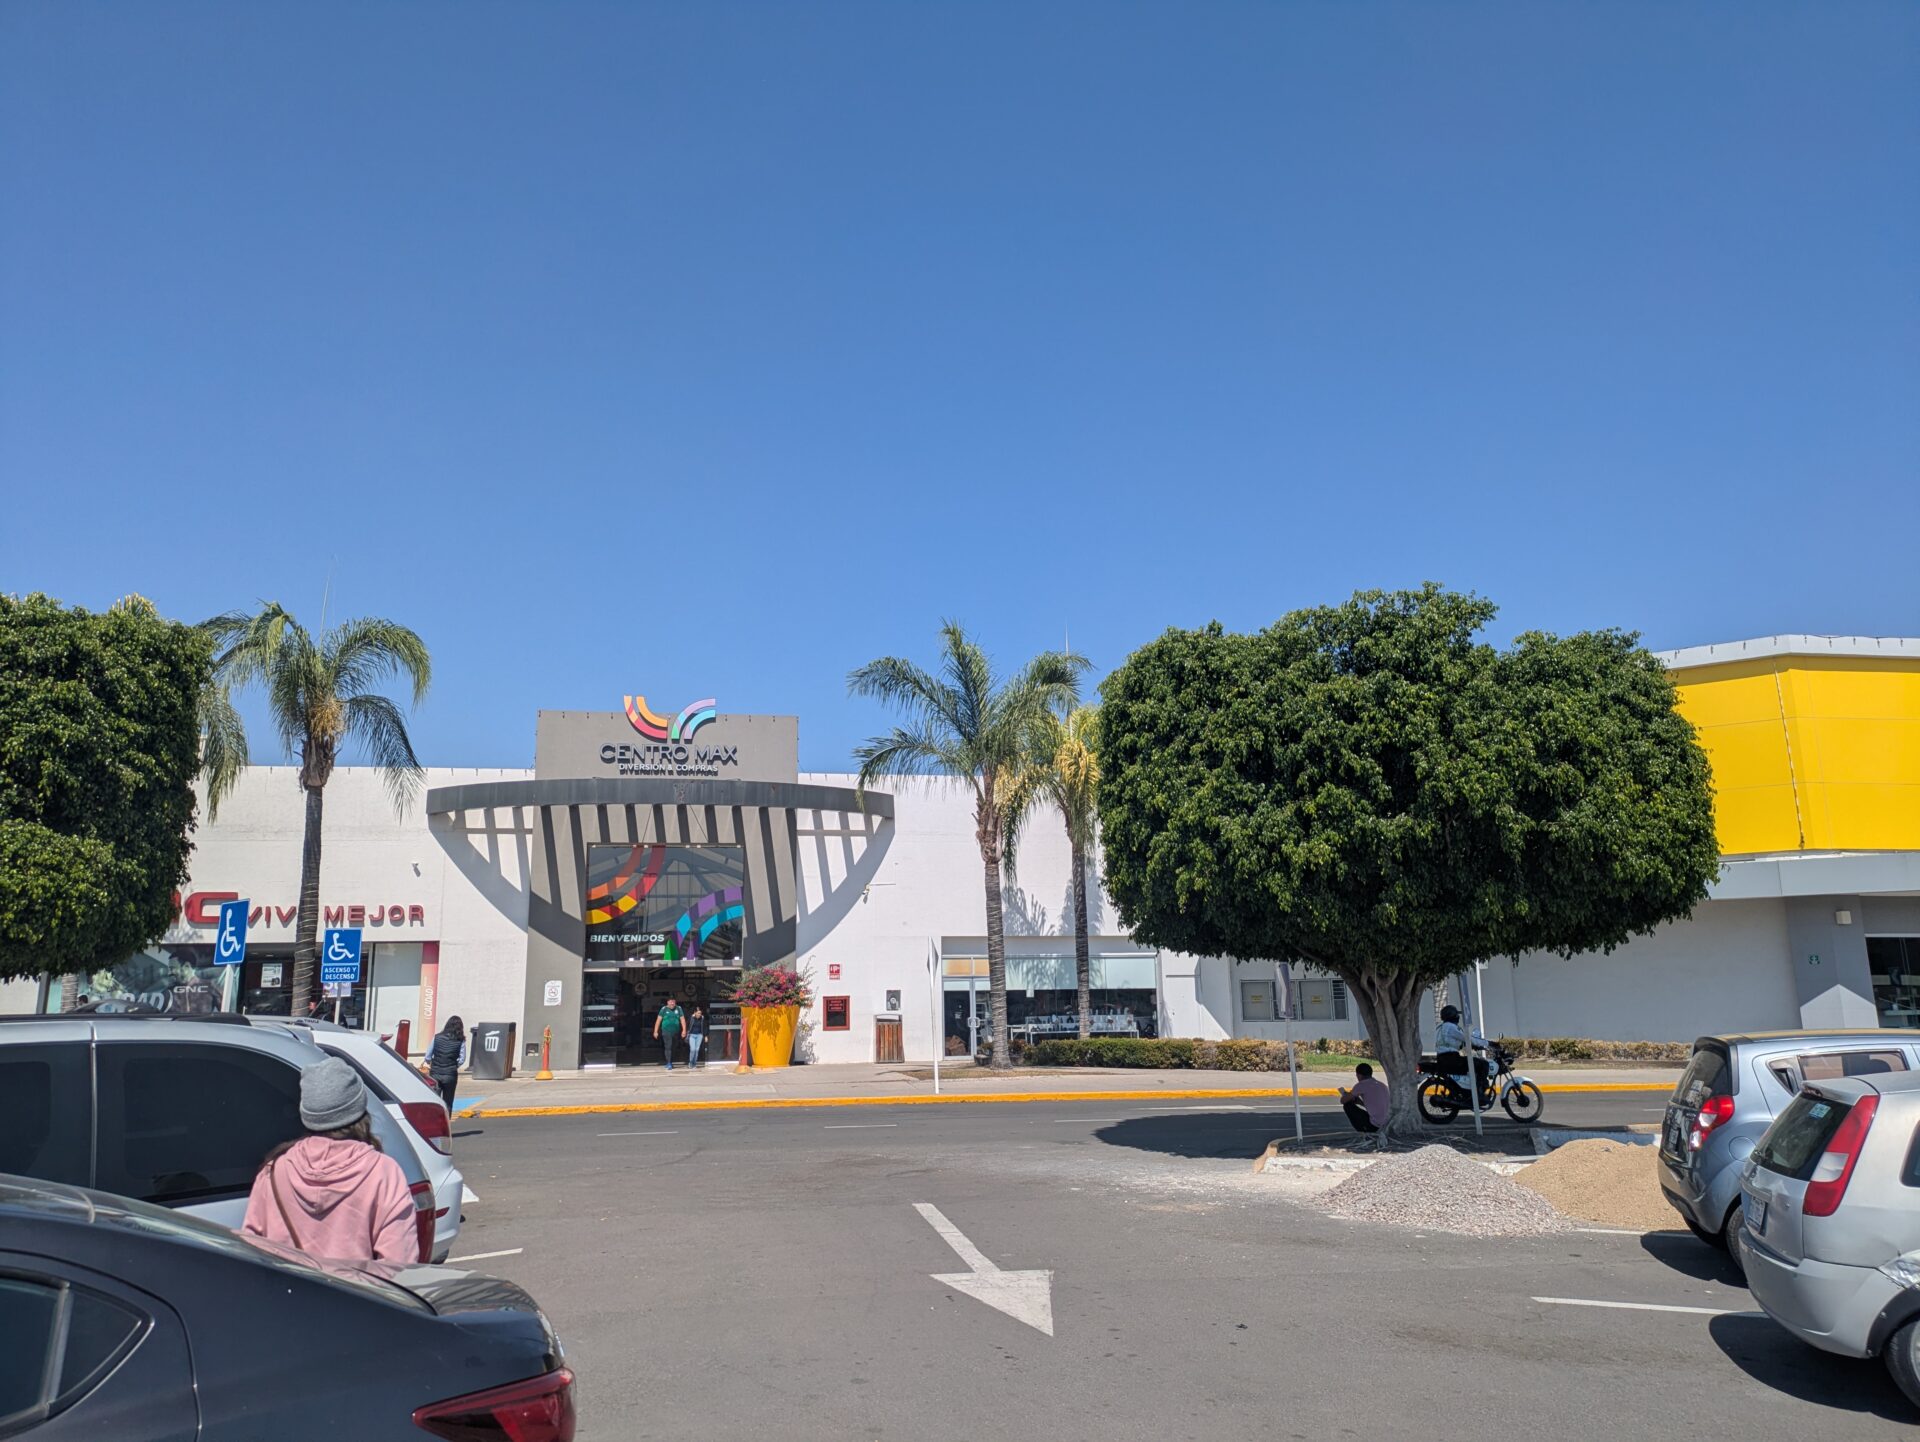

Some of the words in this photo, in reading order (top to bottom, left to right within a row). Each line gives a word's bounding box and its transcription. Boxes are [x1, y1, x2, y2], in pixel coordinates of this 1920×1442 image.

[600, 743, 689, 764] CENTRO
[694, 744, 738, 765] MAX
[675, 764, 718, 773] COMPRAS
[247, 905, 297, 926] VIV
[323, 904, 425, 926] MEJOR
[590, 933, 665, 943] BIENVENIDOS
[173, 985, 209, 993] GNC
